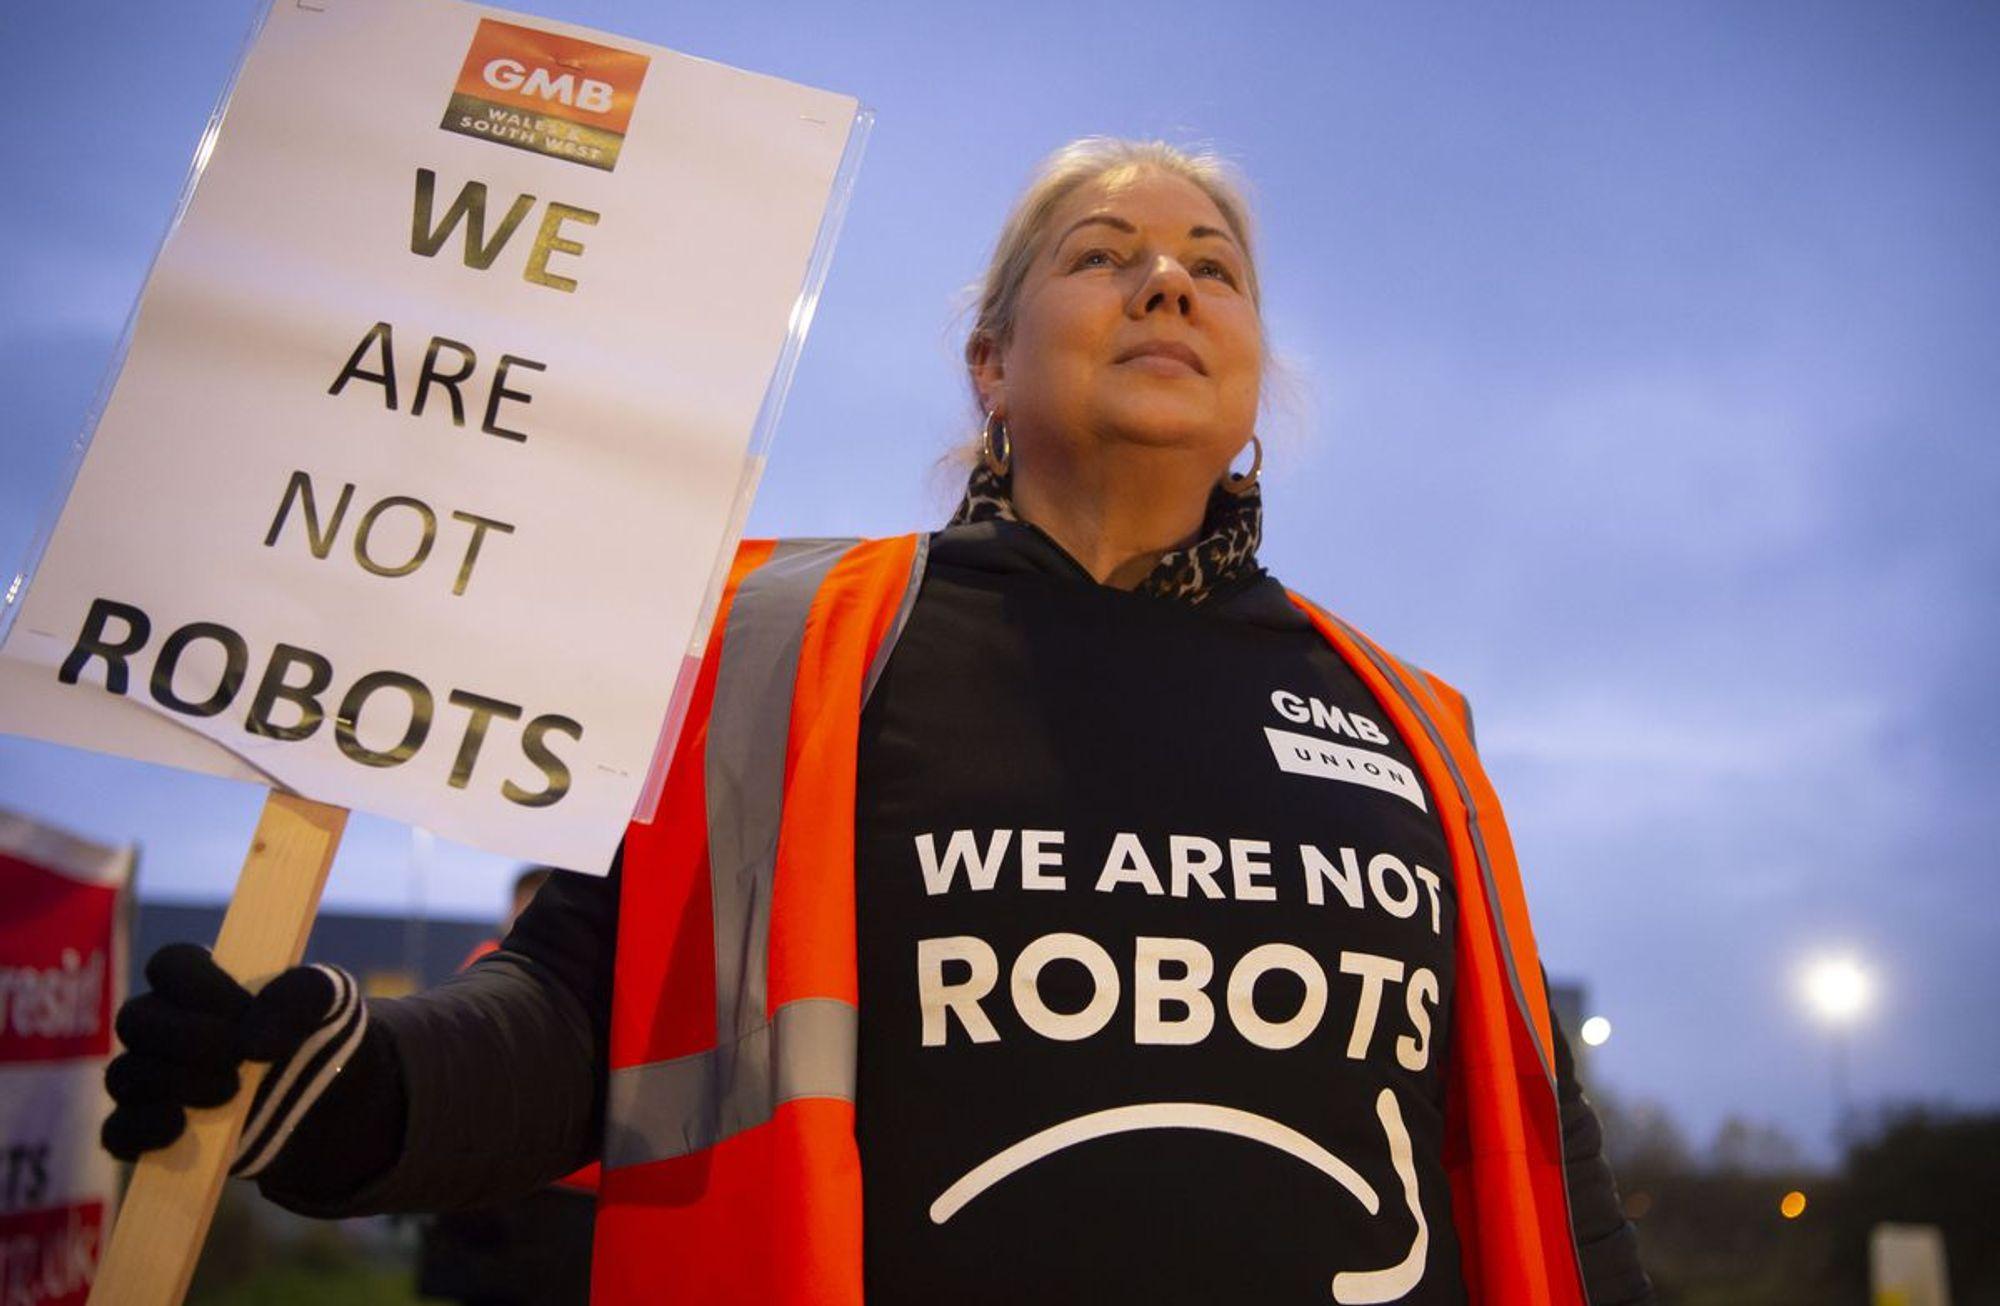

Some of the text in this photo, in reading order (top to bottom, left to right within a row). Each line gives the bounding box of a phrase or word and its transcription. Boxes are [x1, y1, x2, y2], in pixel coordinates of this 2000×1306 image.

[460, 116, 601, 160] SOUTH WEST
[483, 58, 615, 113] GMB
[410, 168, 600, 293] WE
[328, 322, 547, 443] ARE
[264, 471, 515, 595] NOT
[58, 597, 583, 808] ROBOTS
[1271, 690, 1389, 746] GMB
[1294, 747, 1405, 785] UNION
[914, 829, 1441, 935] WE ARE NOT
[917, 932, 1440, 1073] ROBOTS
